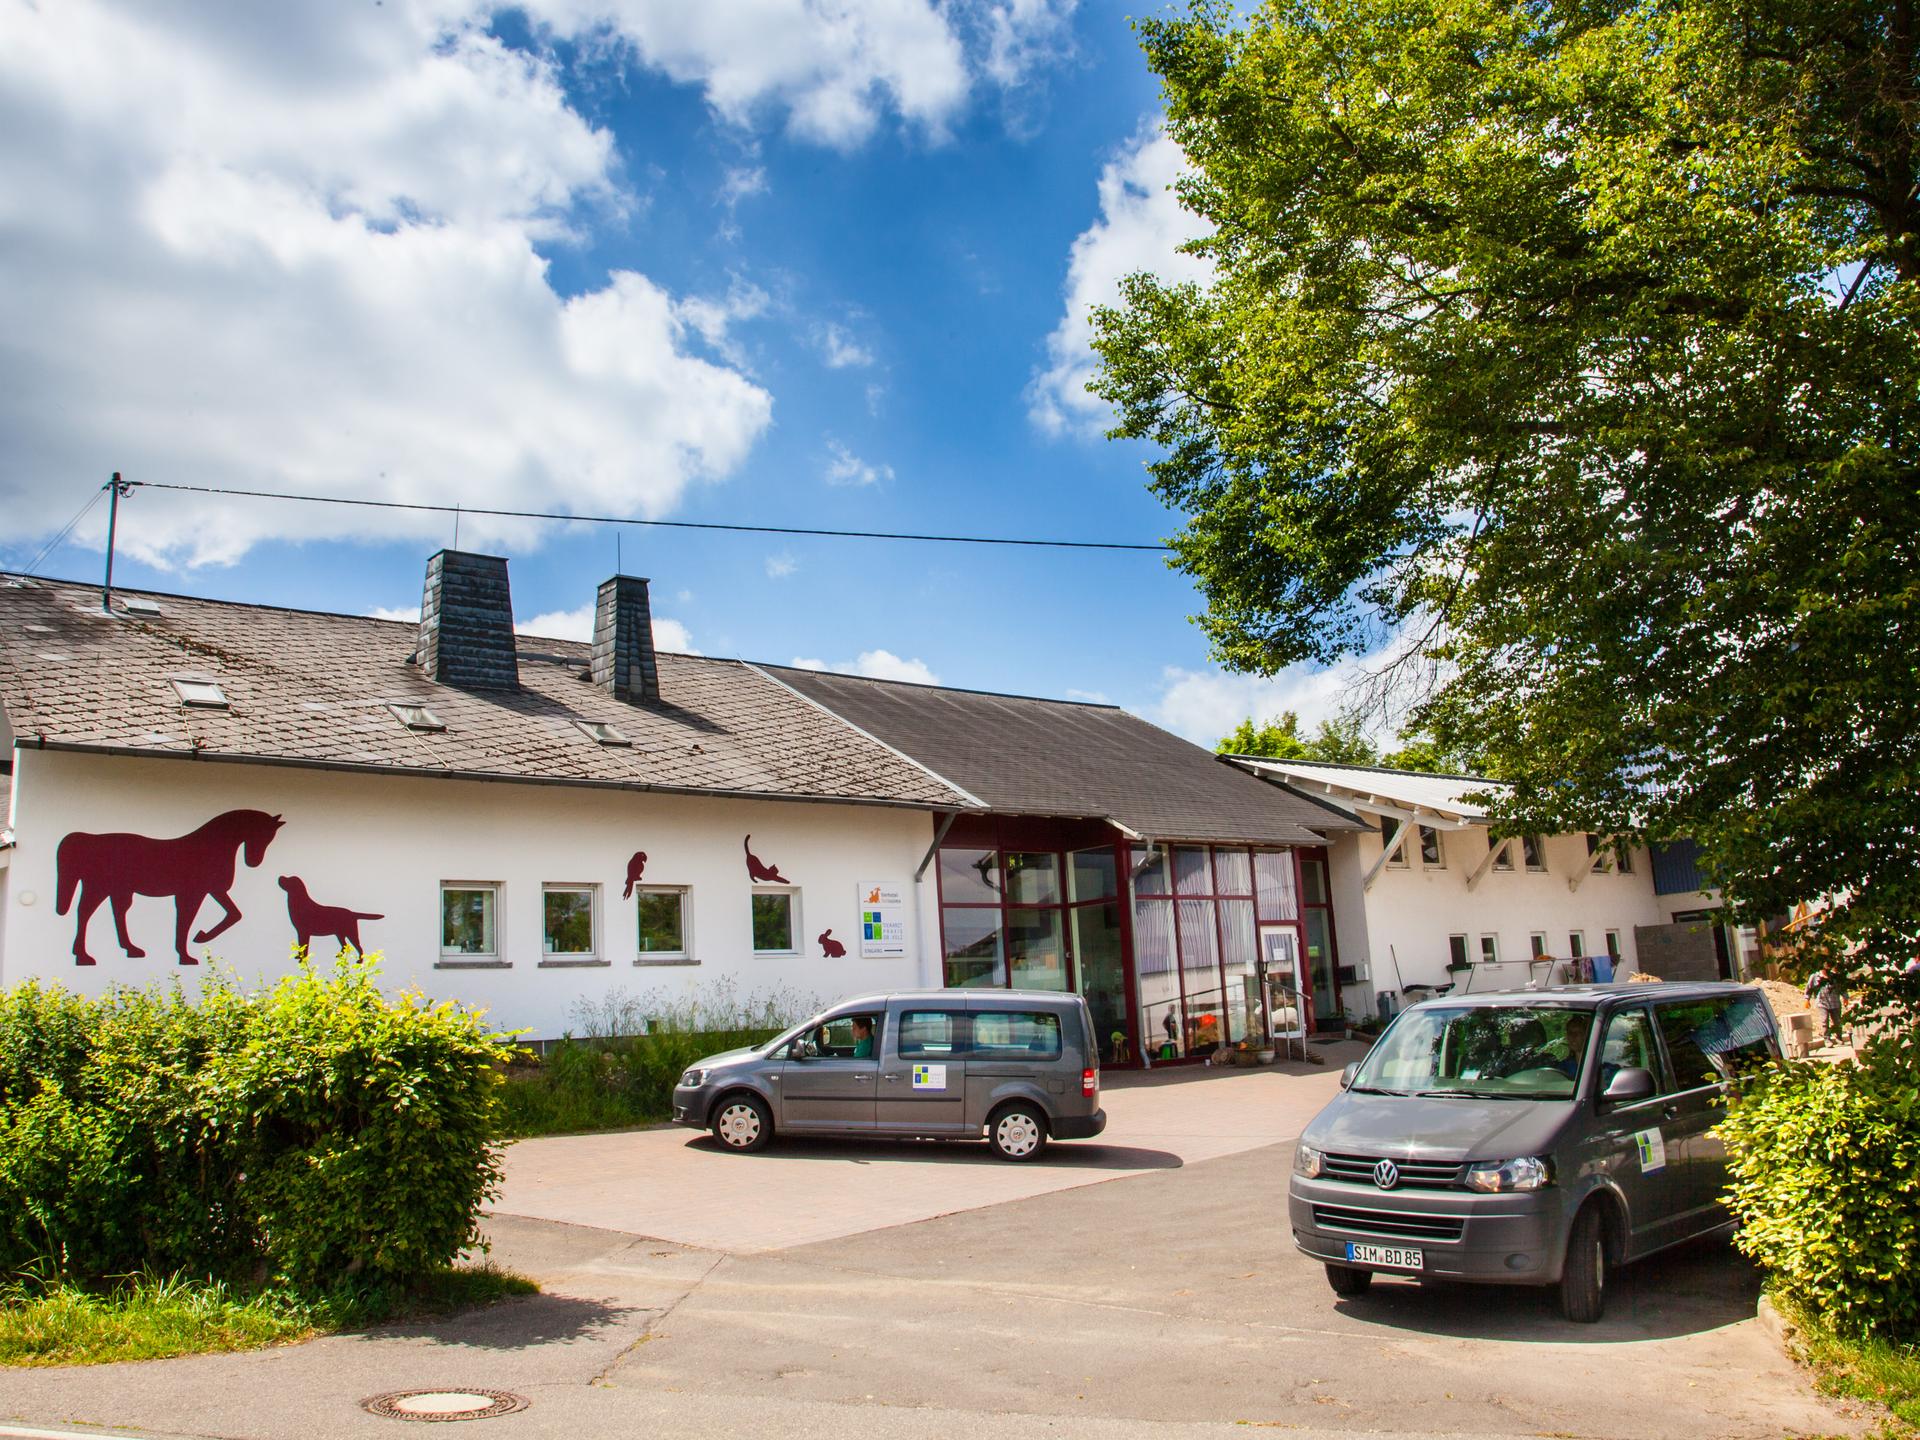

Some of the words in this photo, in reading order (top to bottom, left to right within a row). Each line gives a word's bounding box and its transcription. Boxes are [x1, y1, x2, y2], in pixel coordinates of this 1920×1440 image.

[1354, 1246, 1378, 1262] SIM
[1385, 1249, 1402, 1265] BD
[1404, 1251, 1421, 1266] 85
